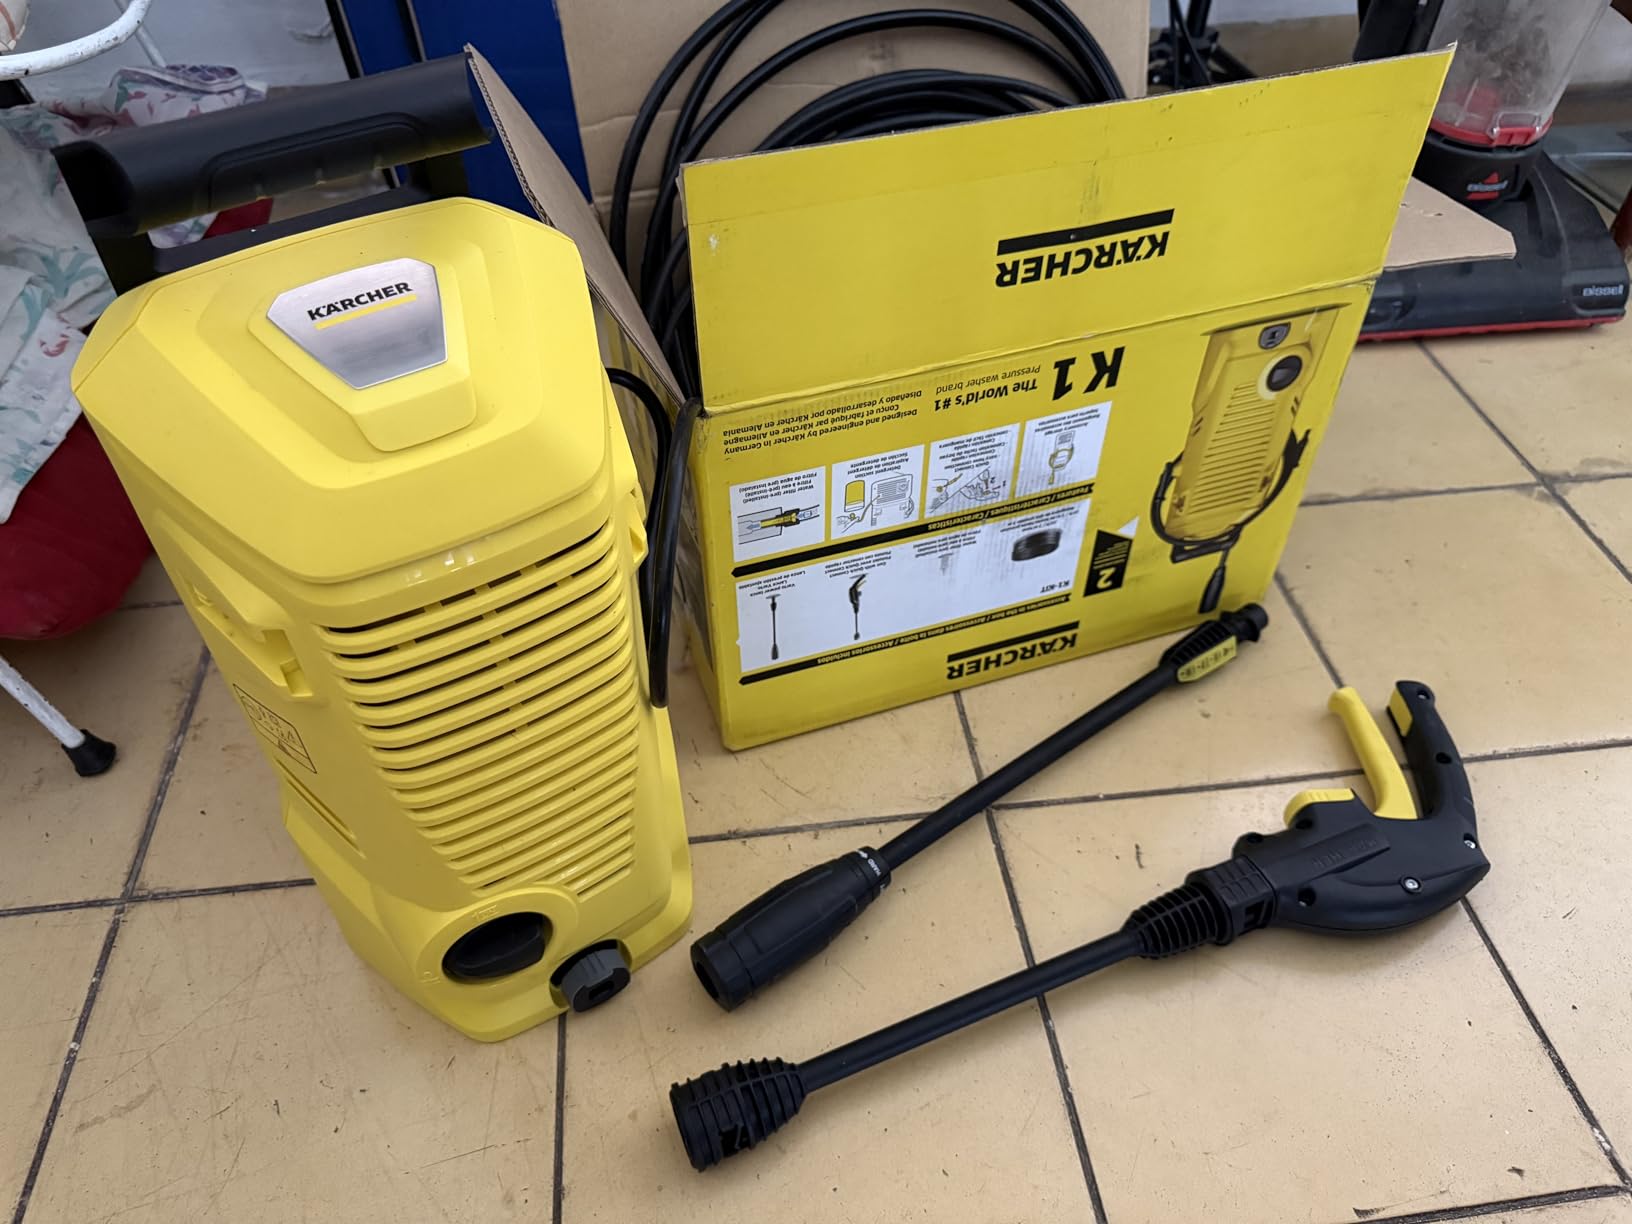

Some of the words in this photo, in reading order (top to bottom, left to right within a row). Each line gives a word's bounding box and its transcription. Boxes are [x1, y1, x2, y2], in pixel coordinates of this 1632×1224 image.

[995, 231, 1170, 288] KÄRCHER
[307, 282, 413, 321] KÄRCHER
[1001, 364, 1041, 379] Pressure
[1082, 346, 1125, 393] K
[965, 374, 999, 387] washer
[1012, 378, 1037, 392] The
[1052, 357, 1077, 400] 1
[935, 381, 963, 395] brand
[955, 385, 1008, 405] World's
[878, 396, 884, 404] y
[885, 390, 922, 403] Diseñado
[826, 399, 877, 415] desarrollado
[875, 404, 899, 414] Conçu
[934, 397, 951, 411] #1
[776, 414, 809, 426] Kärcher
[810, 409, 825, 419] por
[830, 411, 864, 425] fabriqué
[866, 409, 874, 417] et
[881, 408, 917, 422] Designed
[781, 422, 813, 434] Kärcher
[815, 417, 829, 427] par
[819, 420, 864, 436] engineered
[865, 416, 880, 426] and
[722, 423, 762, 437] Alemania
[806, 430, 817, 438] by
[723, 432, 767, 445] Allemagne
[763, 439, 771, 447] in
[773, 433, 805, 444] Kärcher
[724, 442, 762, 454] Germany
[1096, 567, 1115, 589] 2
[947, 633, 1077, 679] KÄRCHER
